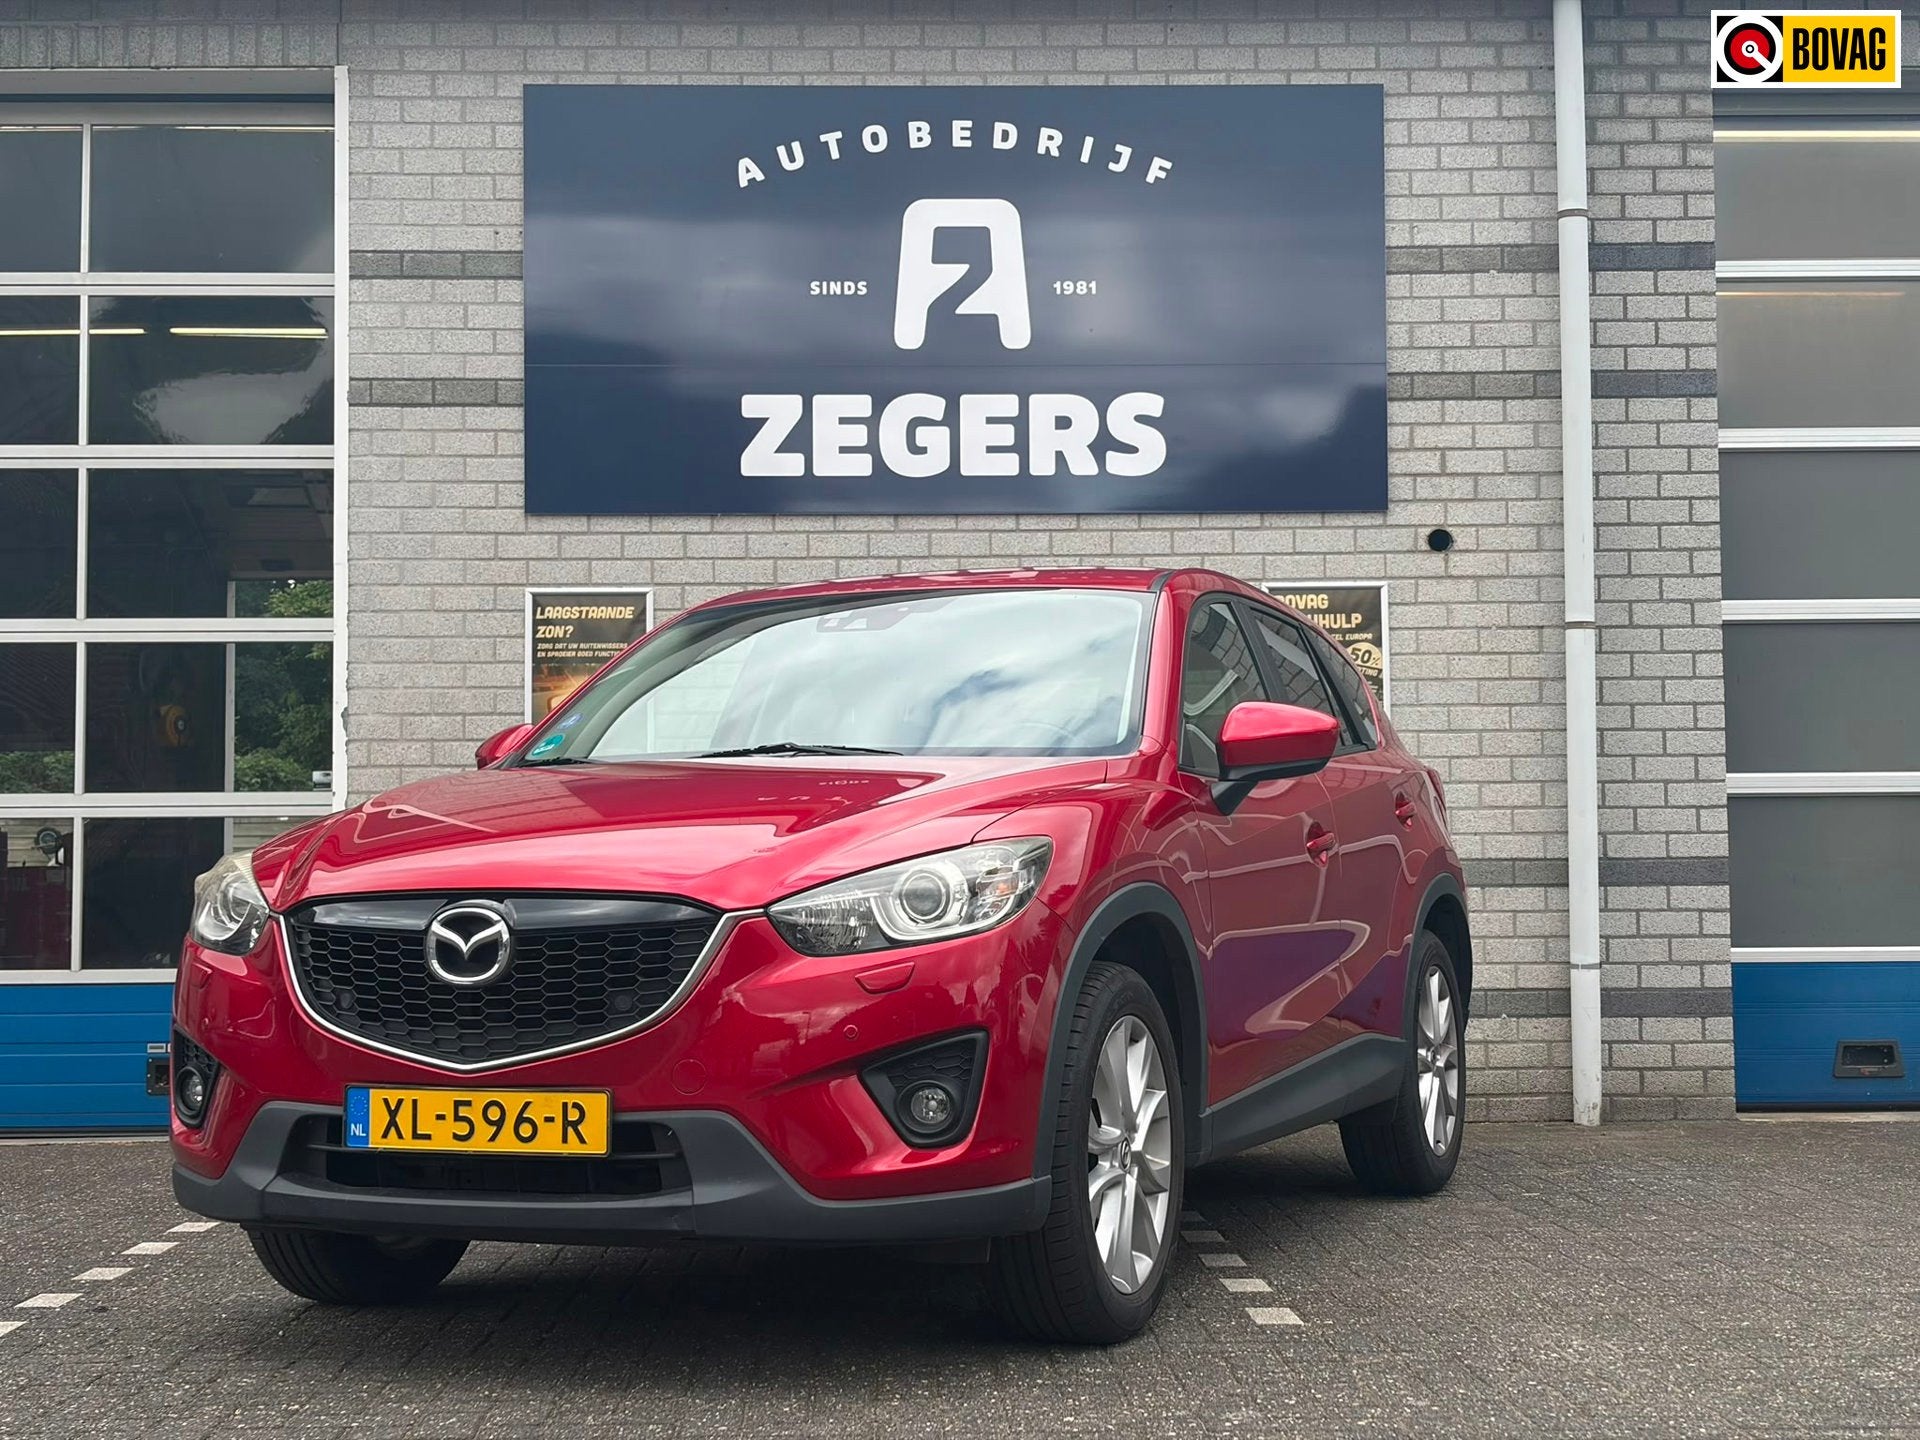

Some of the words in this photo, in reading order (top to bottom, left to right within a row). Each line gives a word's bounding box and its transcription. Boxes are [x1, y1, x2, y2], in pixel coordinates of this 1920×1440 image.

[737, 120, 1173, 188] AUTOBEDRIJF
[810, 281, 868, 295] SINDS
[1053, 280, 1097, 295] 1981
[740, 391, 1167, 478] ZEGERS
[535, 606, 635, 619] LAAGSTAANDE
[535, 625, 574, 638] ZON?
[1350, 647, 1380, 666] 50%
[350, 1123, 366, 1137] NL
[381, 1097, 588, 1144] XL-596-R
